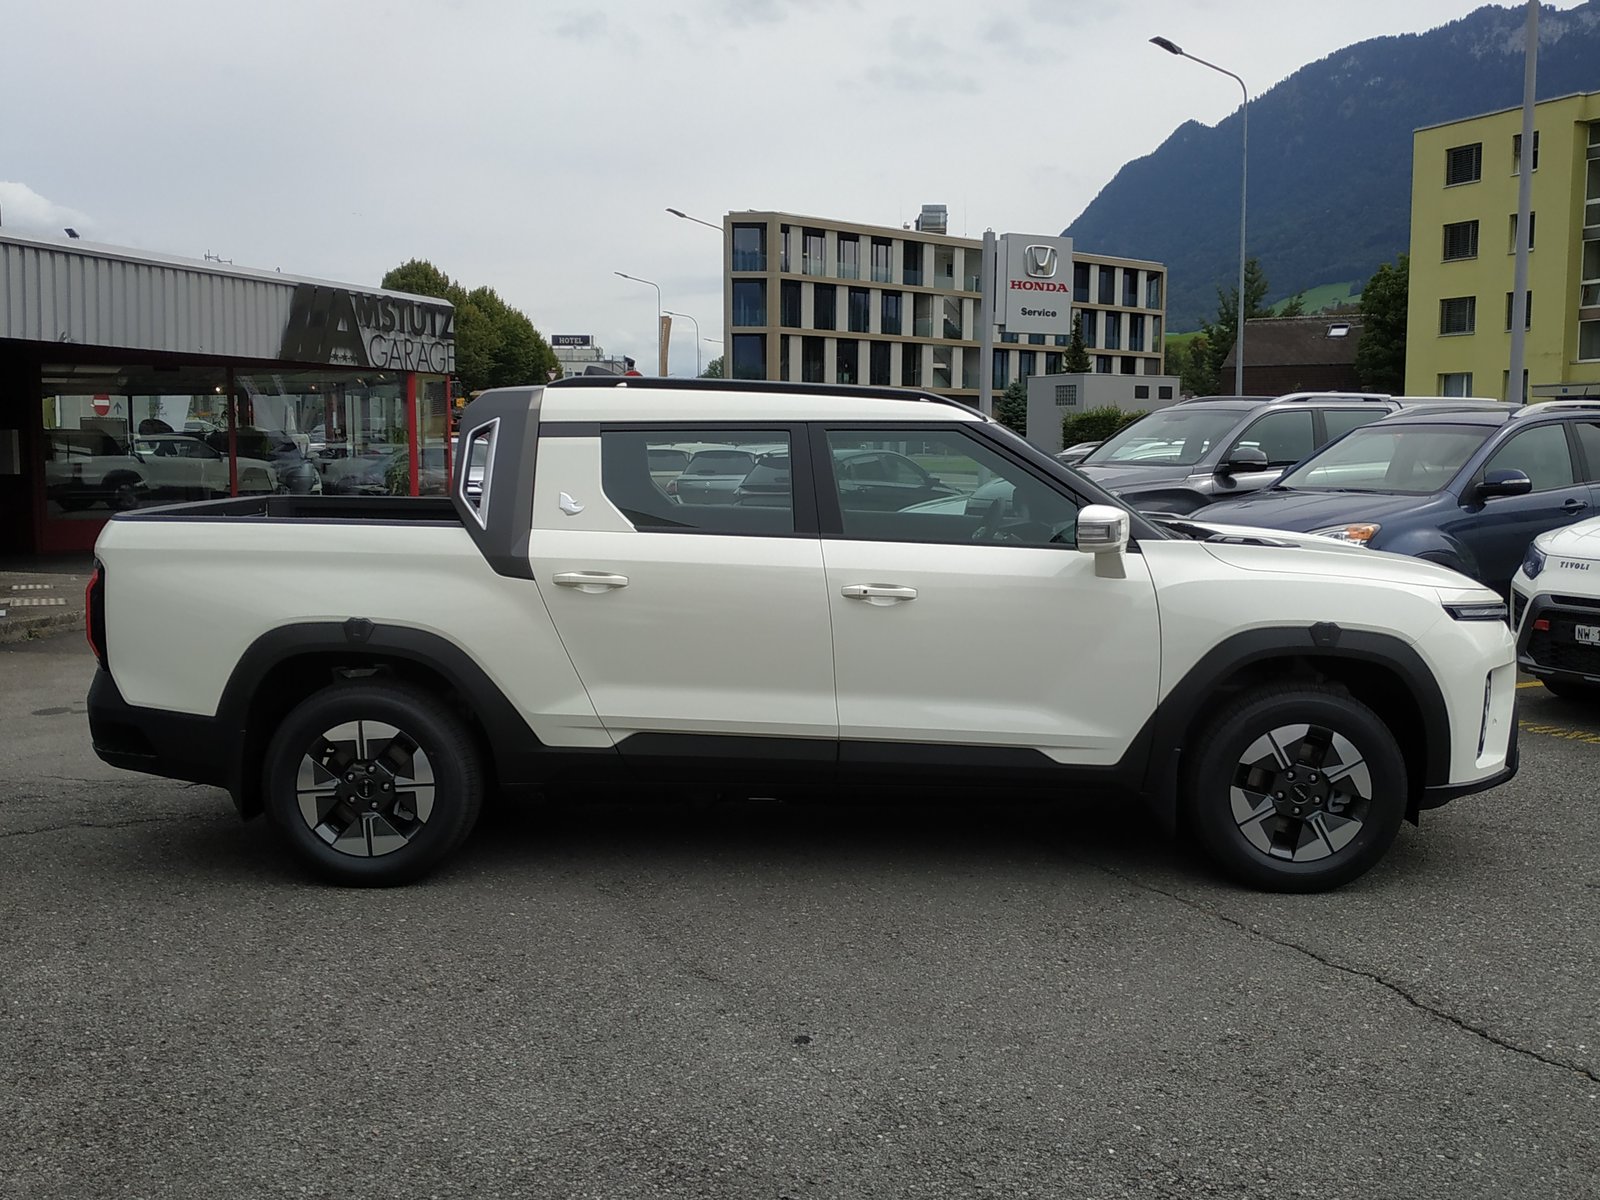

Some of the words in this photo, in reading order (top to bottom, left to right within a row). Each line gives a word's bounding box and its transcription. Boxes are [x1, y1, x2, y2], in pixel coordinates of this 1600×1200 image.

[1010, 280, 1069, 293] HONDA
[1021, 307, 1057, 318] Service
[316, 285, 455, 365] AMSTUTZ
[559, 337, 584, 345] HOTEL
[369, 334, 455, 375] GARAGE
[1560, 561, 1590, 571] TIVOLI
